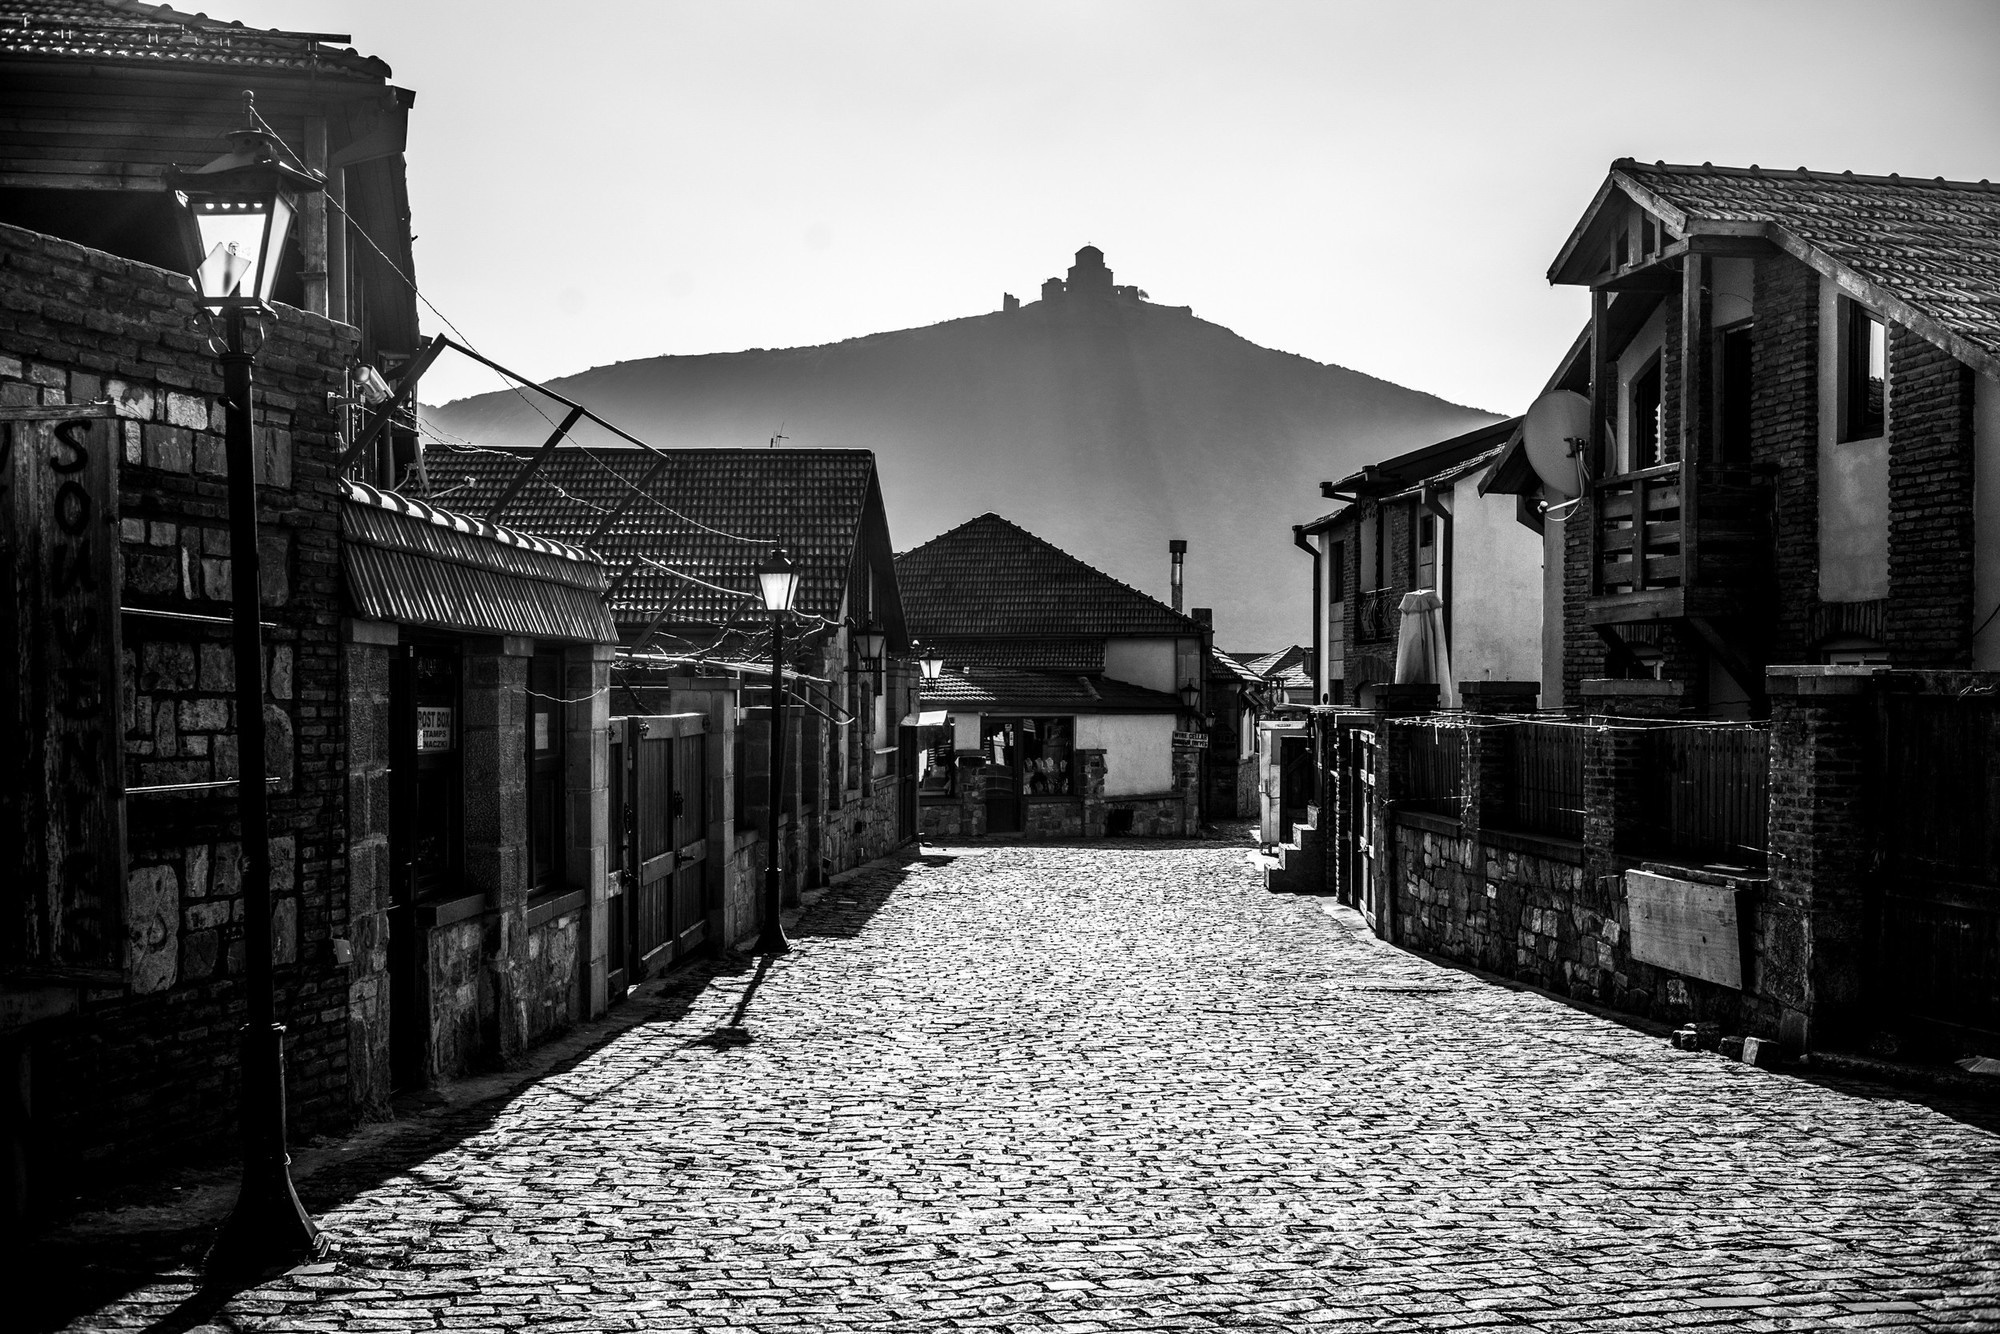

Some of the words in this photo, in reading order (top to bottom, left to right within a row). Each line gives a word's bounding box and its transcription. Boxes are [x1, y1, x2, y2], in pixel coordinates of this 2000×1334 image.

[417, 711, 436, 728] POST
[437, 711, 450, 728] BOX
[423, 740, 447, 748] NACZKI
